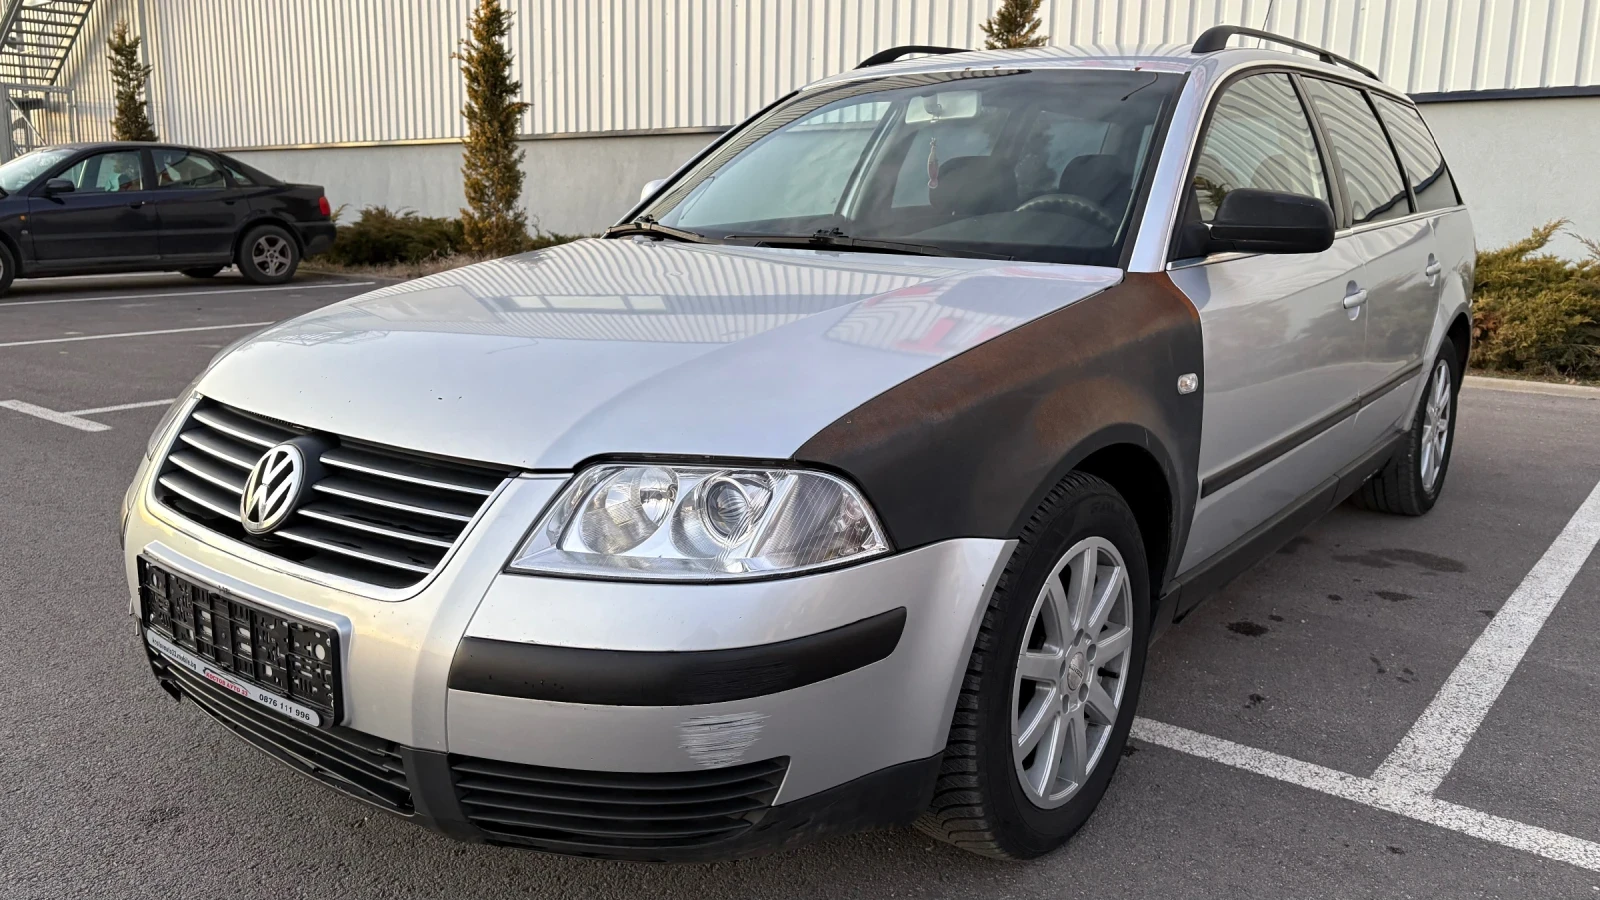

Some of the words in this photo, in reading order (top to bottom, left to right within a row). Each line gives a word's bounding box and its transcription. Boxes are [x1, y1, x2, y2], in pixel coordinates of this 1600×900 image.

[259, 694, 278, 707] 0876
[280, 702, 292, 714] 111
[295, 709, 310, 721] 996
